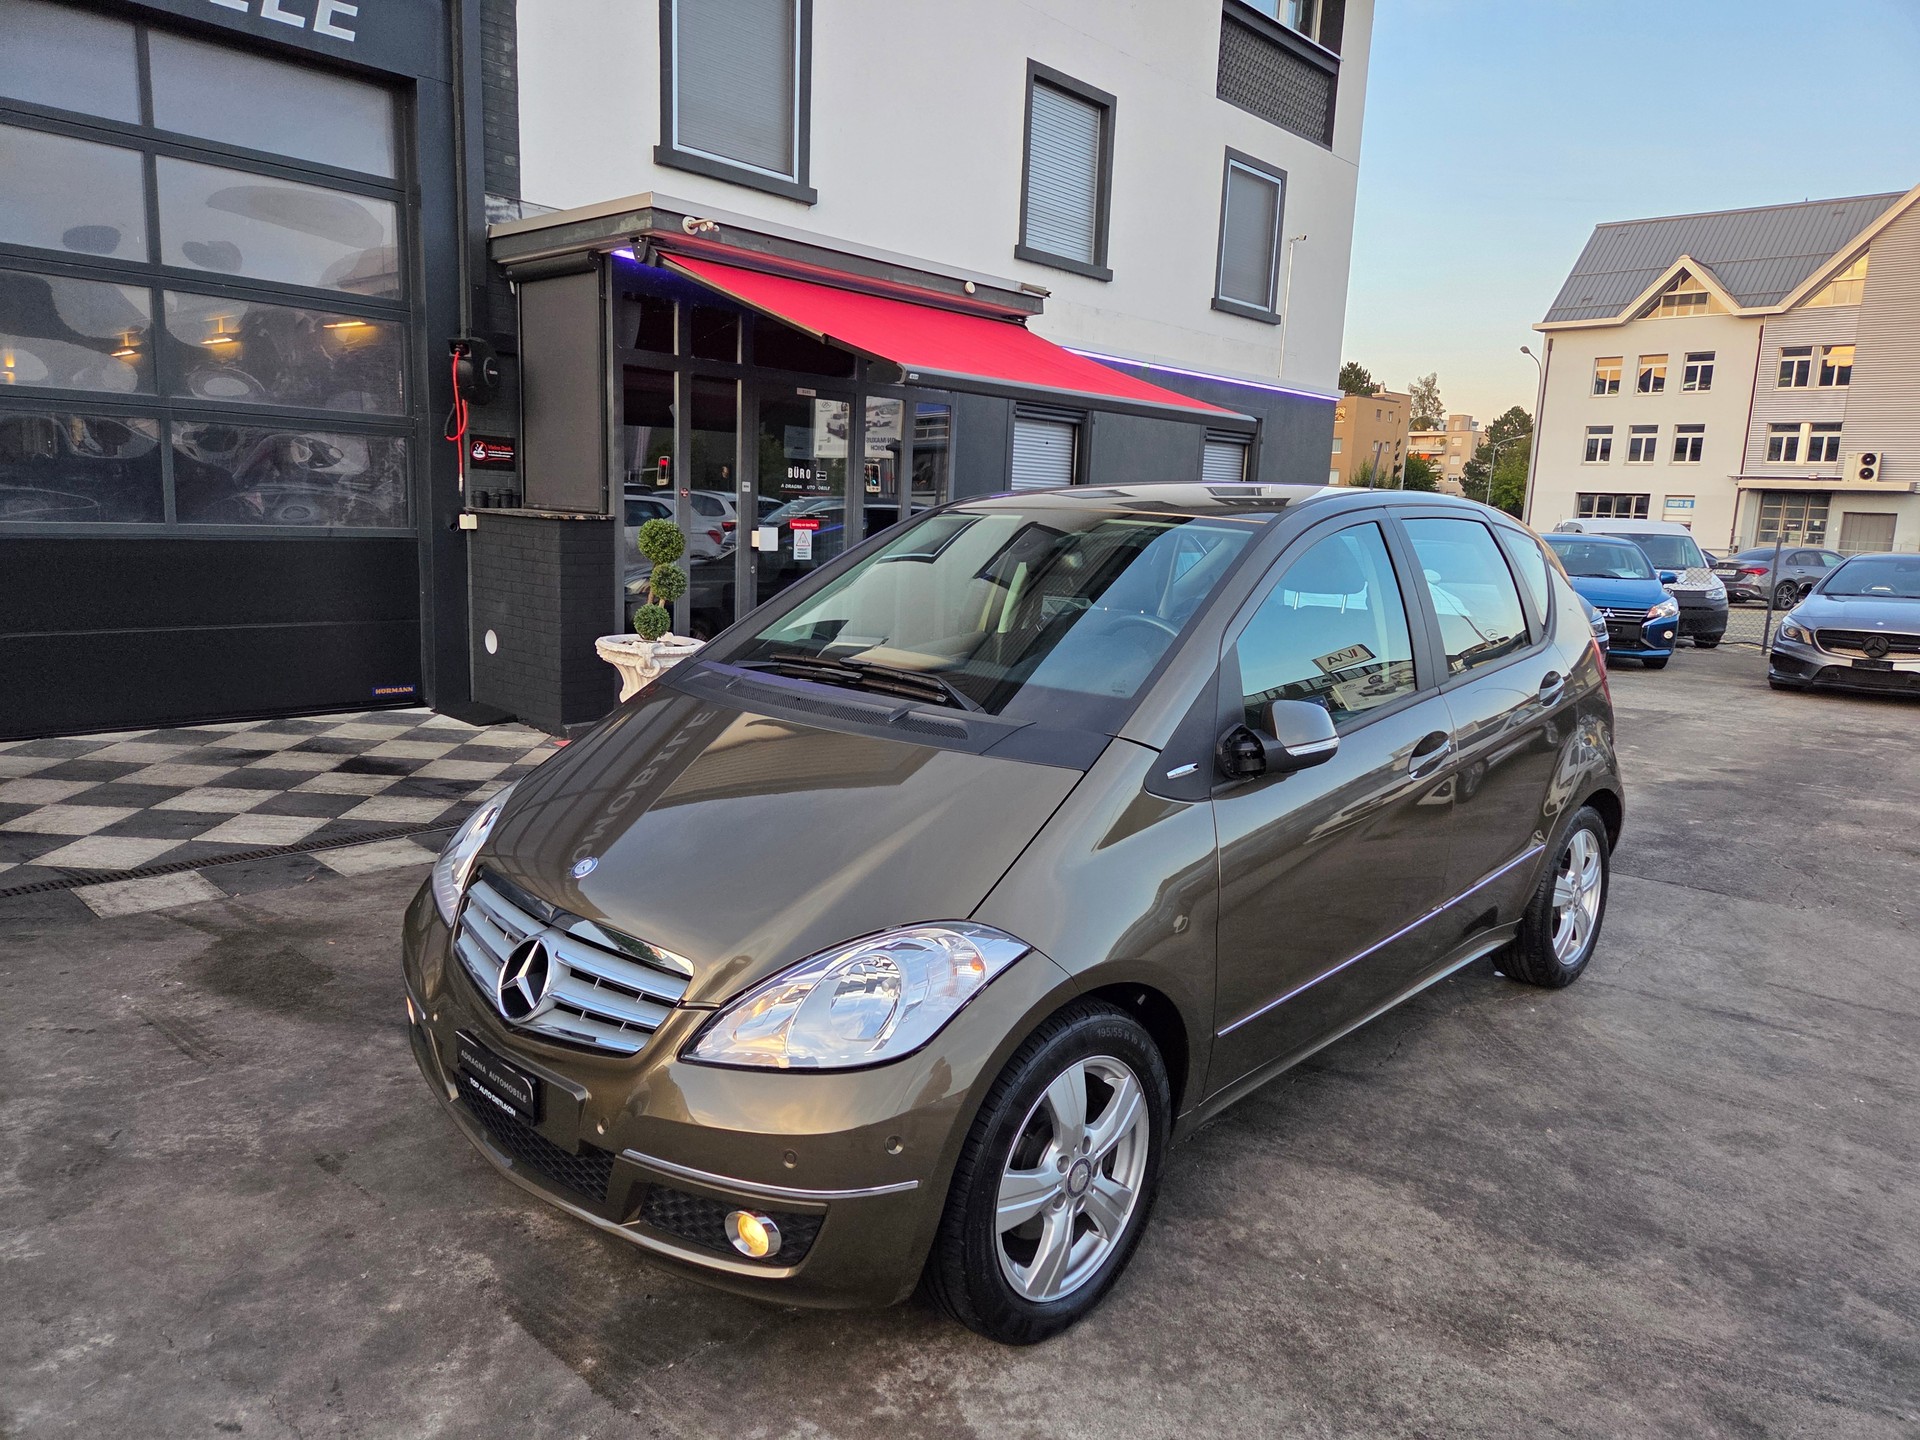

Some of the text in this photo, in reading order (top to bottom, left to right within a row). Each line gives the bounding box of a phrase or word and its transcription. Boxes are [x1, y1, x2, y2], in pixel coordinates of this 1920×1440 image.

[787, 466, 811, 479] BÜRO
[1096, 1027, 1123, 1038] 195/55
[461, 1050, 528, 1103] ADRAGNA AUTOMOBILE
